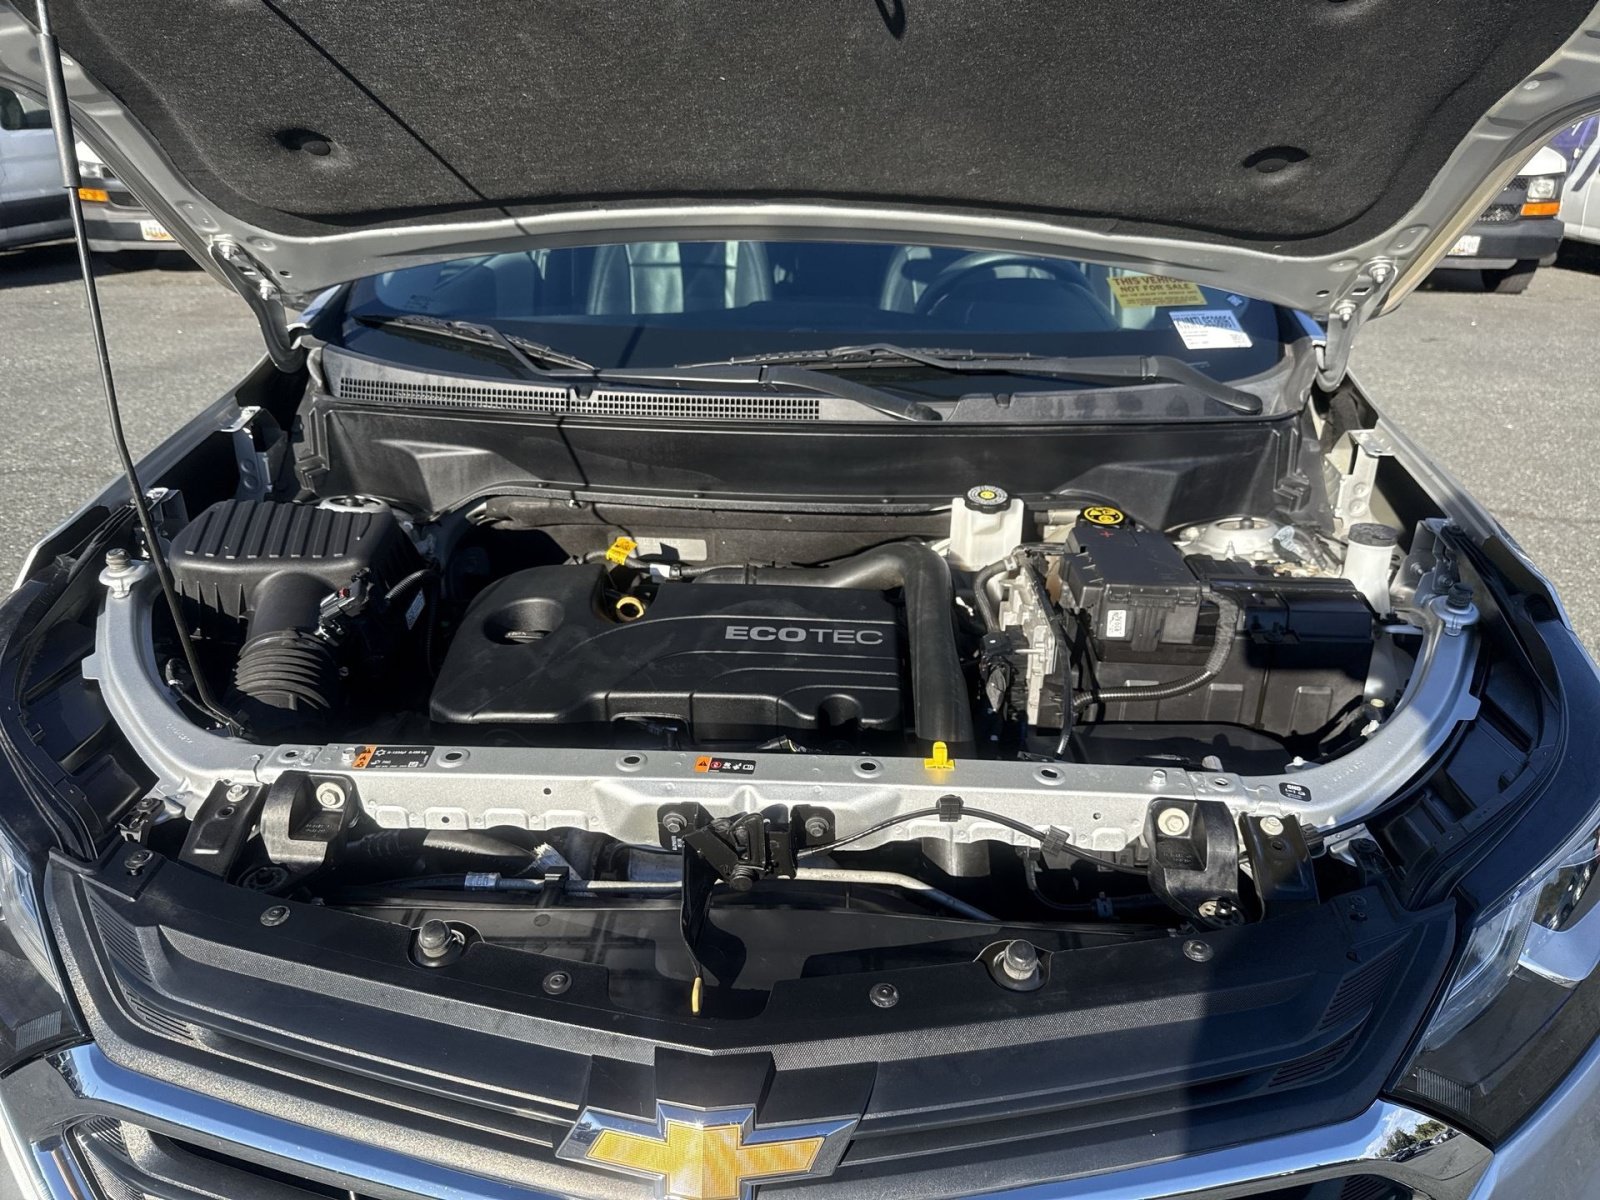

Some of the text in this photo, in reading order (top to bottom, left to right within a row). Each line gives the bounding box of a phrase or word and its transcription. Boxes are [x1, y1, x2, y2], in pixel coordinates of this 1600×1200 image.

[1112, 277, 1140, 286] THIS
[1120, 285, 1140, 293] NOT
[1165, 282, 1192, 290] SALE
[725, 625, 883, 645] ECOTEC
